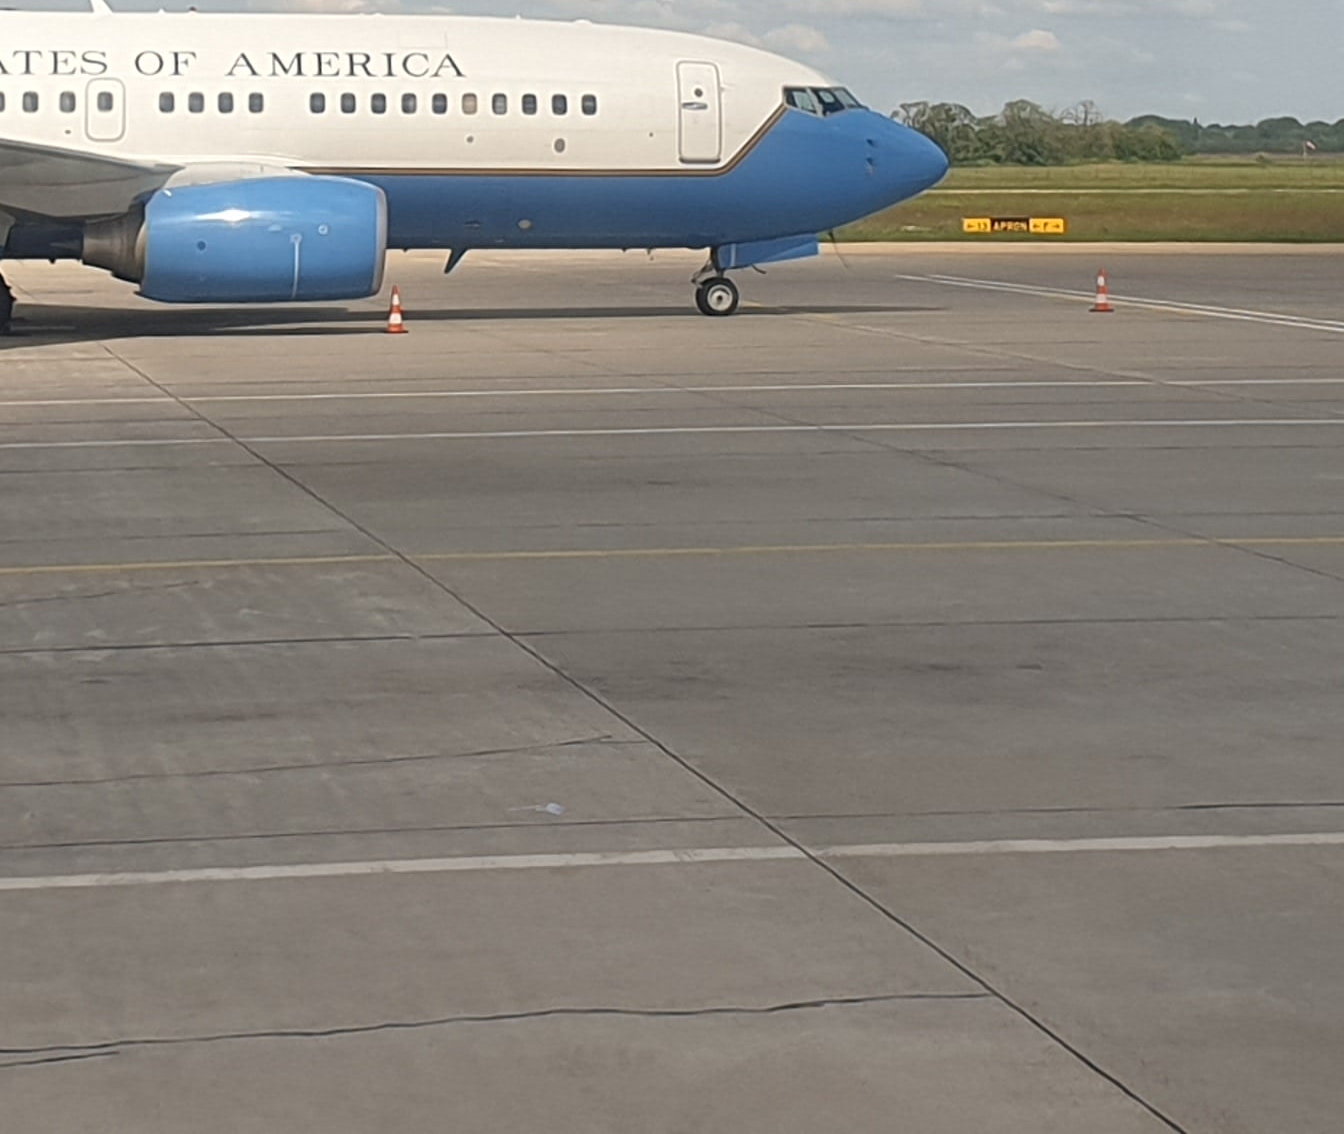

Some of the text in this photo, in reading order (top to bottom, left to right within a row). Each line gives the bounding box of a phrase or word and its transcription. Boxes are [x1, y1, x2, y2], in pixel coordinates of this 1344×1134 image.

[134, 50, 198, 77] OF
[225, 52, 467, 78] AMERICA
[993, 221, 1027, 231] APRON
